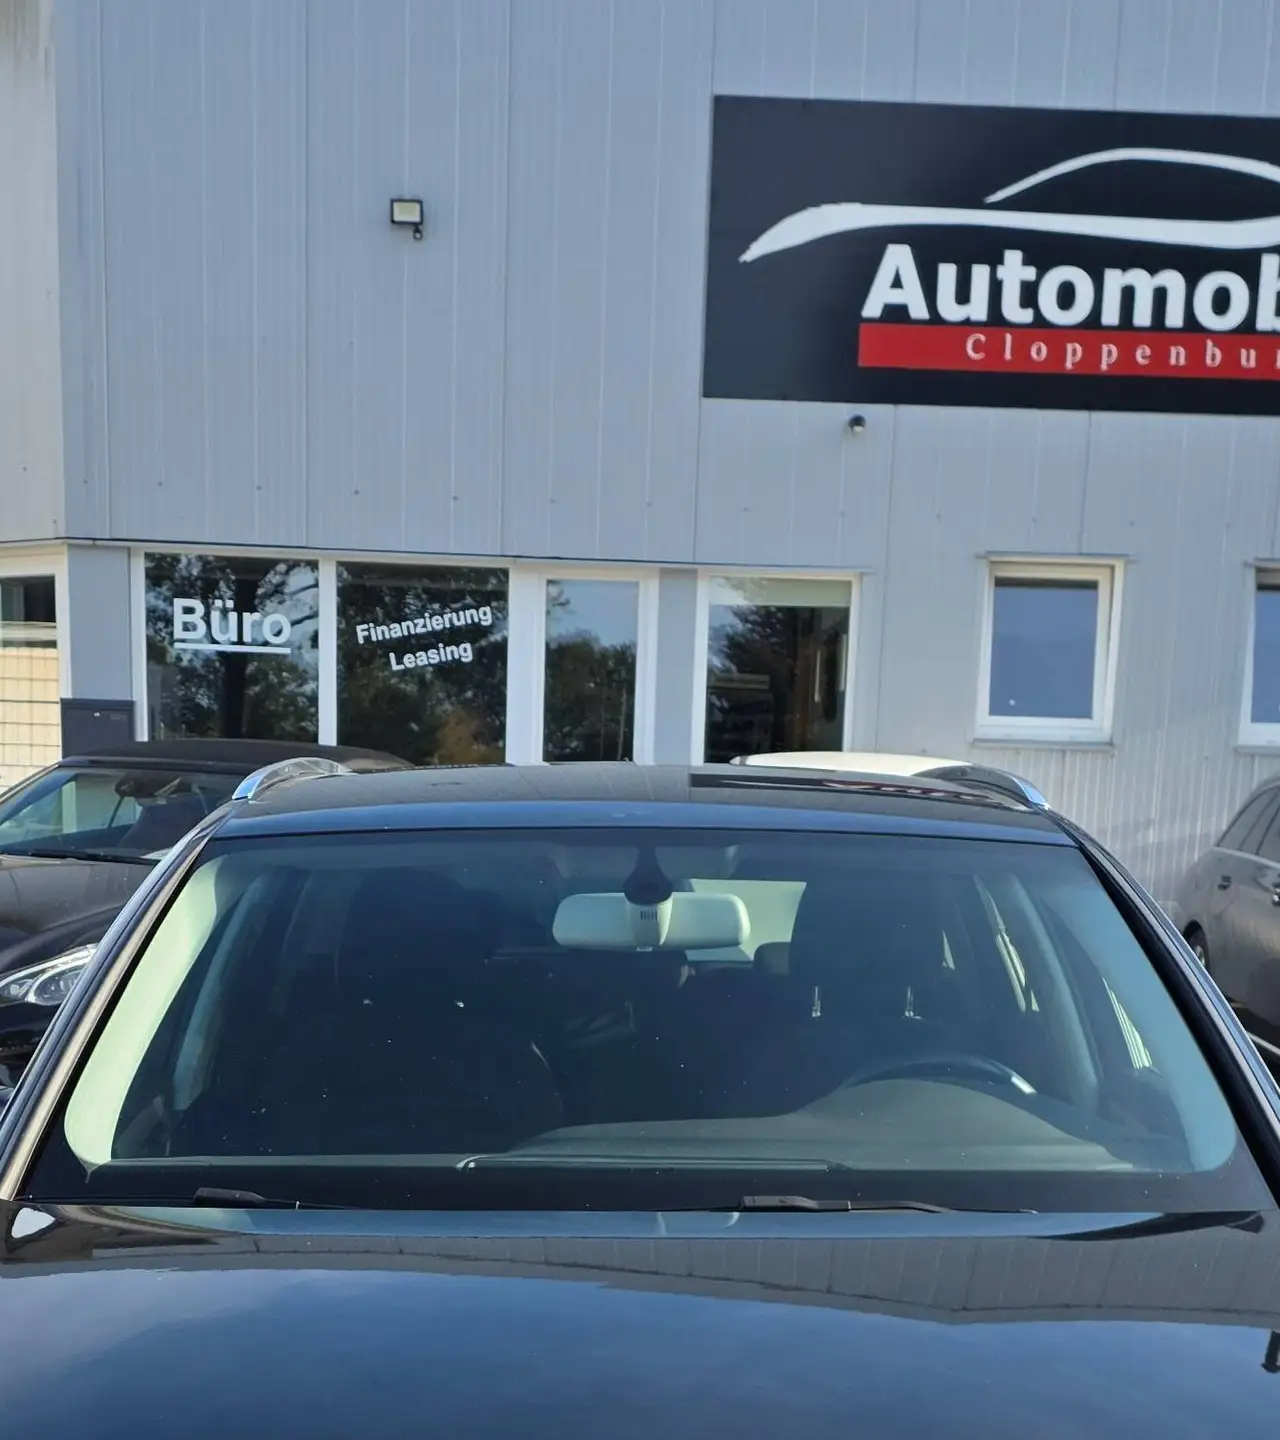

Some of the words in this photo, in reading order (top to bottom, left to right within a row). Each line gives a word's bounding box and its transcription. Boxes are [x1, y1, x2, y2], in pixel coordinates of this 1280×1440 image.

[173, 597, 291, 644] Büro
[355, 603, 493, 646] Finanzierung
[389, 640, 473, 672] Leasing
